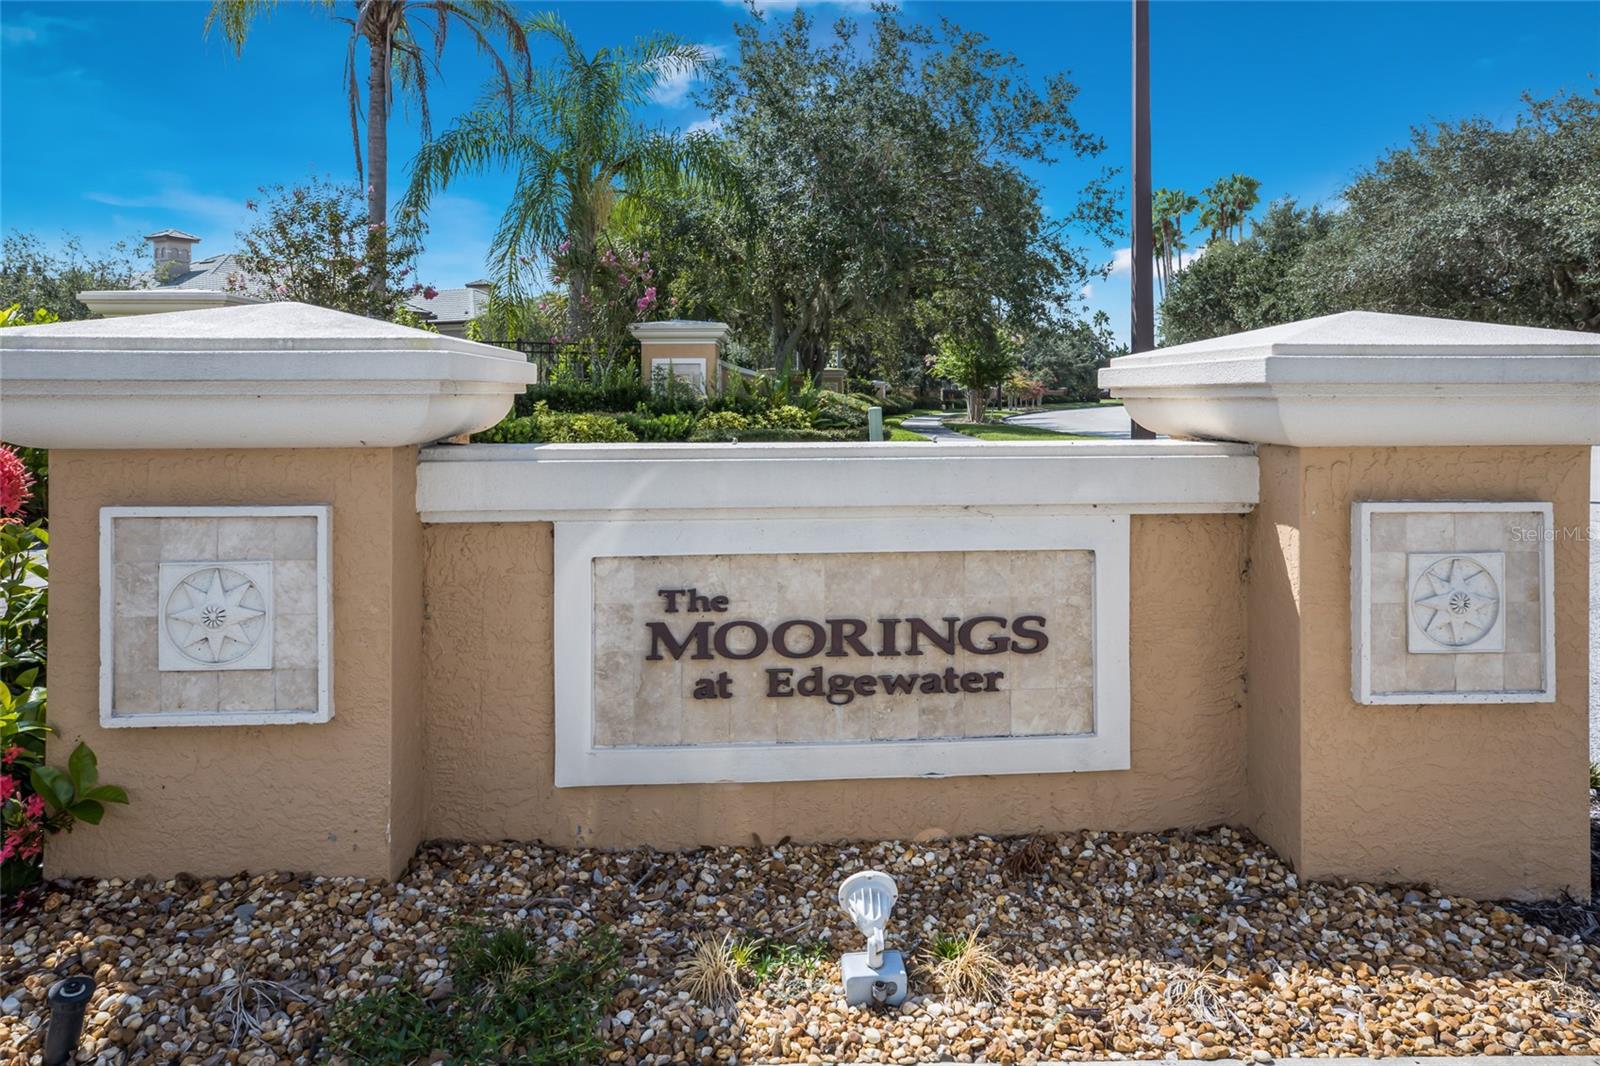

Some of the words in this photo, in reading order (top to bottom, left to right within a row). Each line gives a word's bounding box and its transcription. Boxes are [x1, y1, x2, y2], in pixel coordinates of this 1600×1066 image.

[657, 588, 730, 614] The
[644, 615, 1050, 662] MOORINGS
[692, 671, 734, 701] at
[765, 666, 1005, 706] Edgewater
